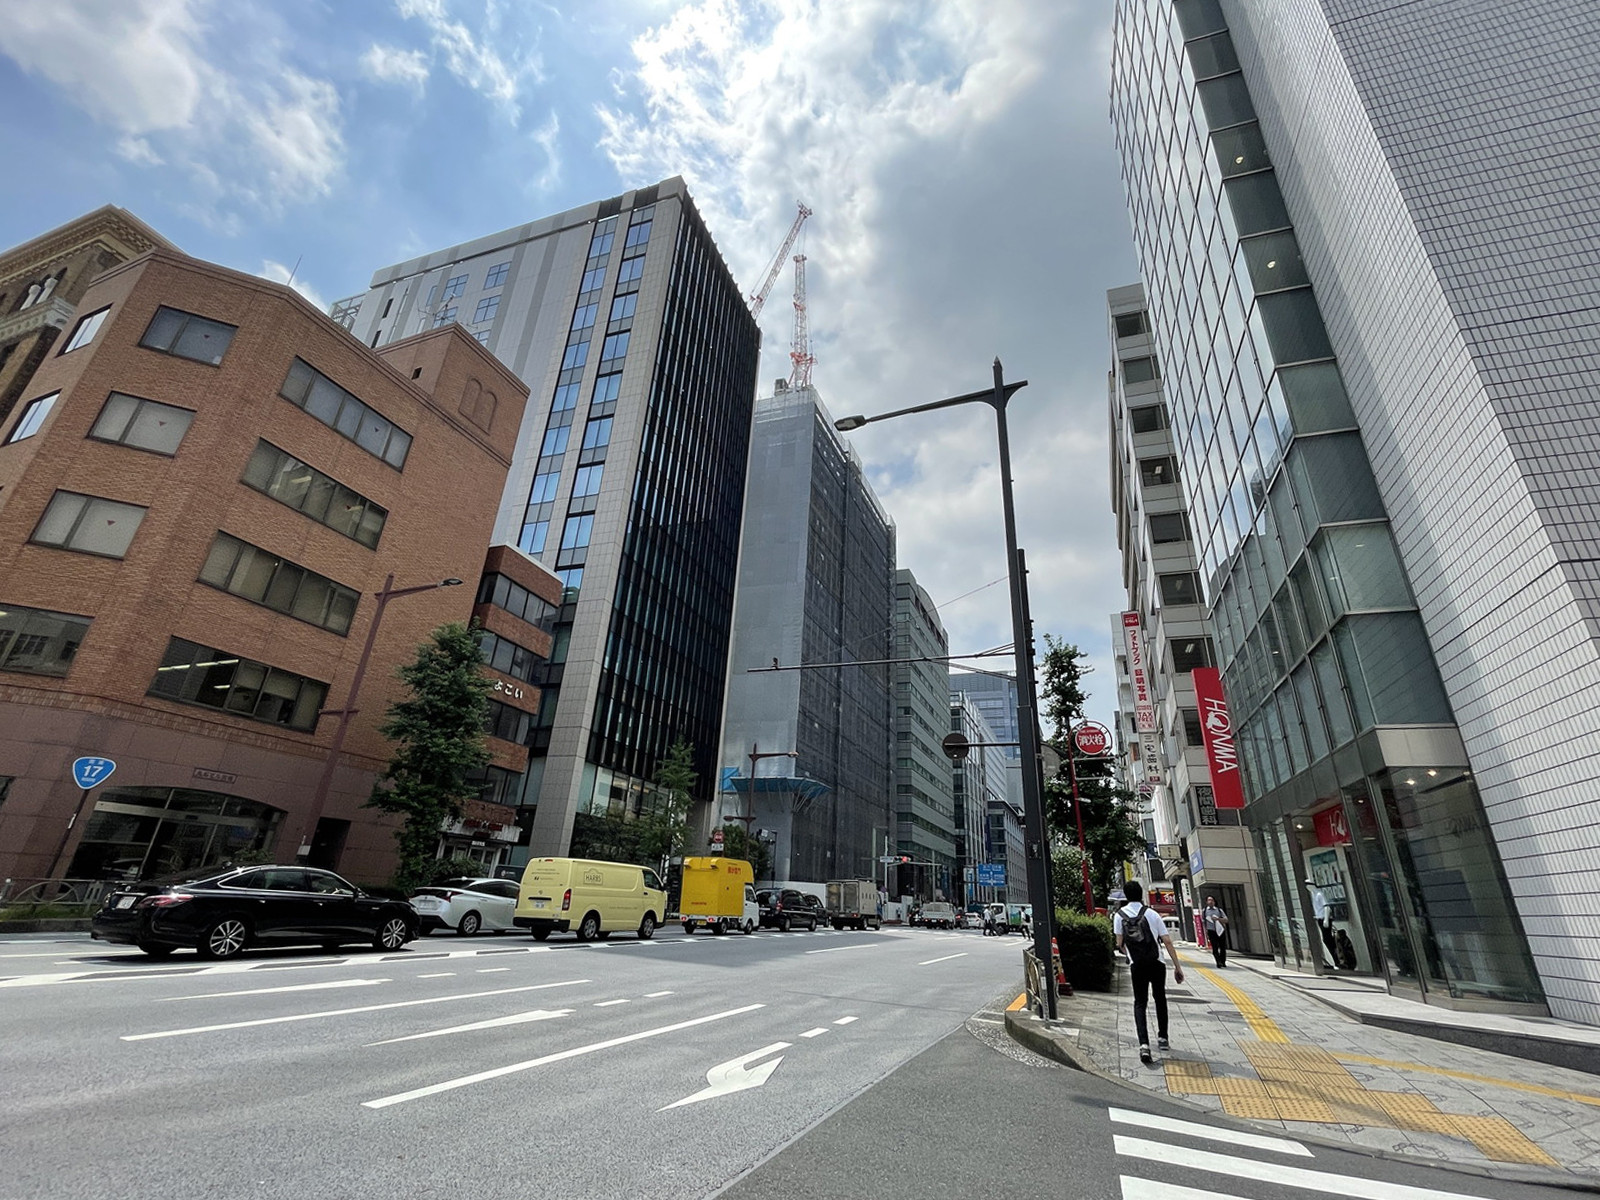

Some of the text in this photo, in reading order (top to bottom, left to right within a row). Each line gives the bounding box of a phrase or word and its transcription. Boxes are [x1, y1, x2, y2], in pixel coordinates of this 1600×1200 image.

[494, 679, 523, 699] よこい
[1078, 733, 1105, 746] 消火栓
[1204, 697, 1239, 773] HONMA
[84, 765, 104, 777] 17
